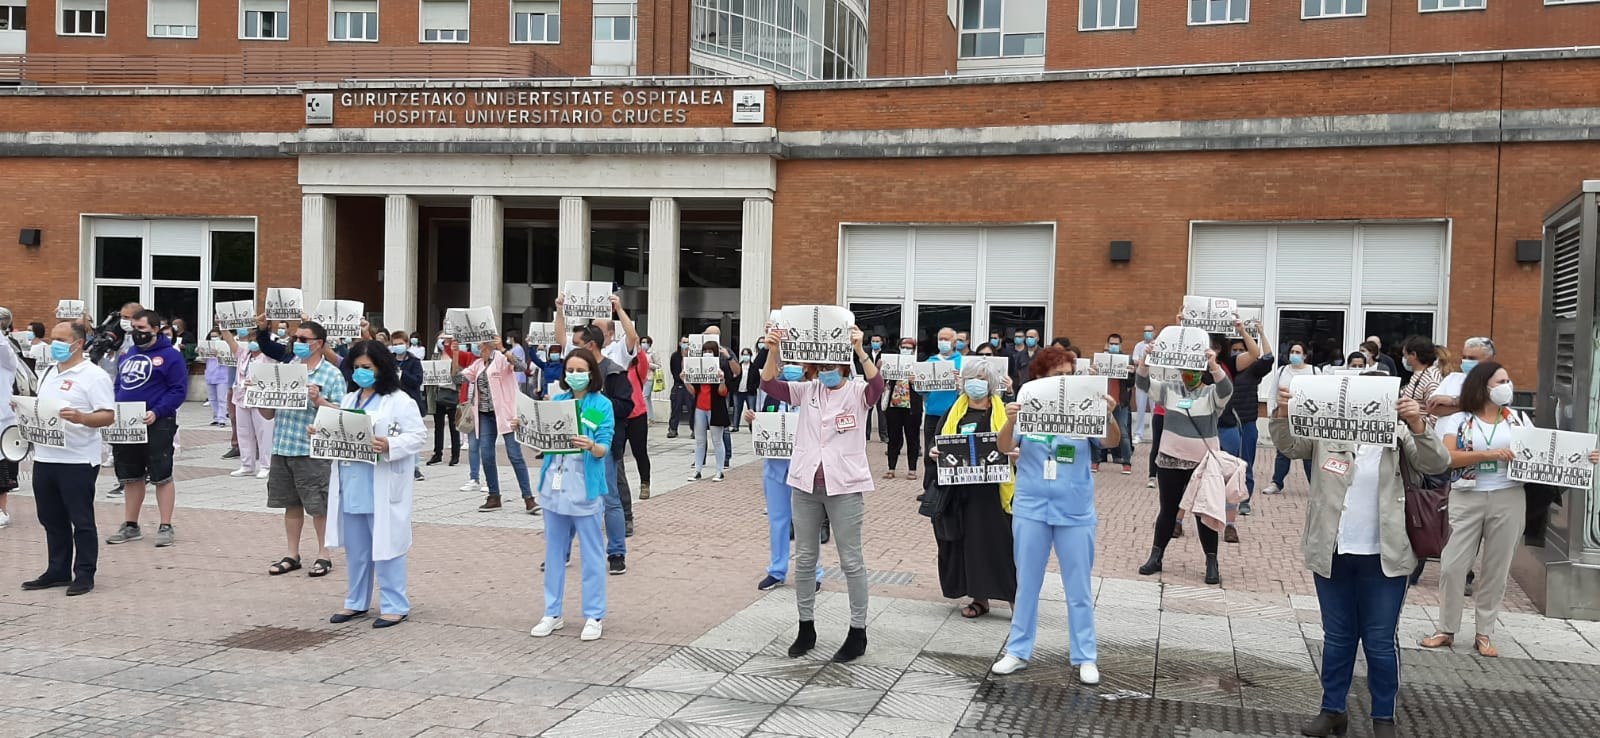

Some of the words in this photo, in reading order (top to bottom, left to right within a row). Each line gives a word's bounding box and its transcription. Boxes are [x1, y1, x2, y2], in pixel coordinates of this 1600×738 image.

[341, 92, 466, 106] GURUTZETAKO
[474, 91, 614, 106] UNIBERTSITATE
[622, 91, 724, 105] OSPITALEA
[373, 110, 457, 124] HOSPITAL
[464, 109, 603, 124] UNIVERSITARIO
[612, 109, 688, 123] CRUCES
[122, 360, 149, 373] UGT
[1314, 428, 1355, 440] AHORA
